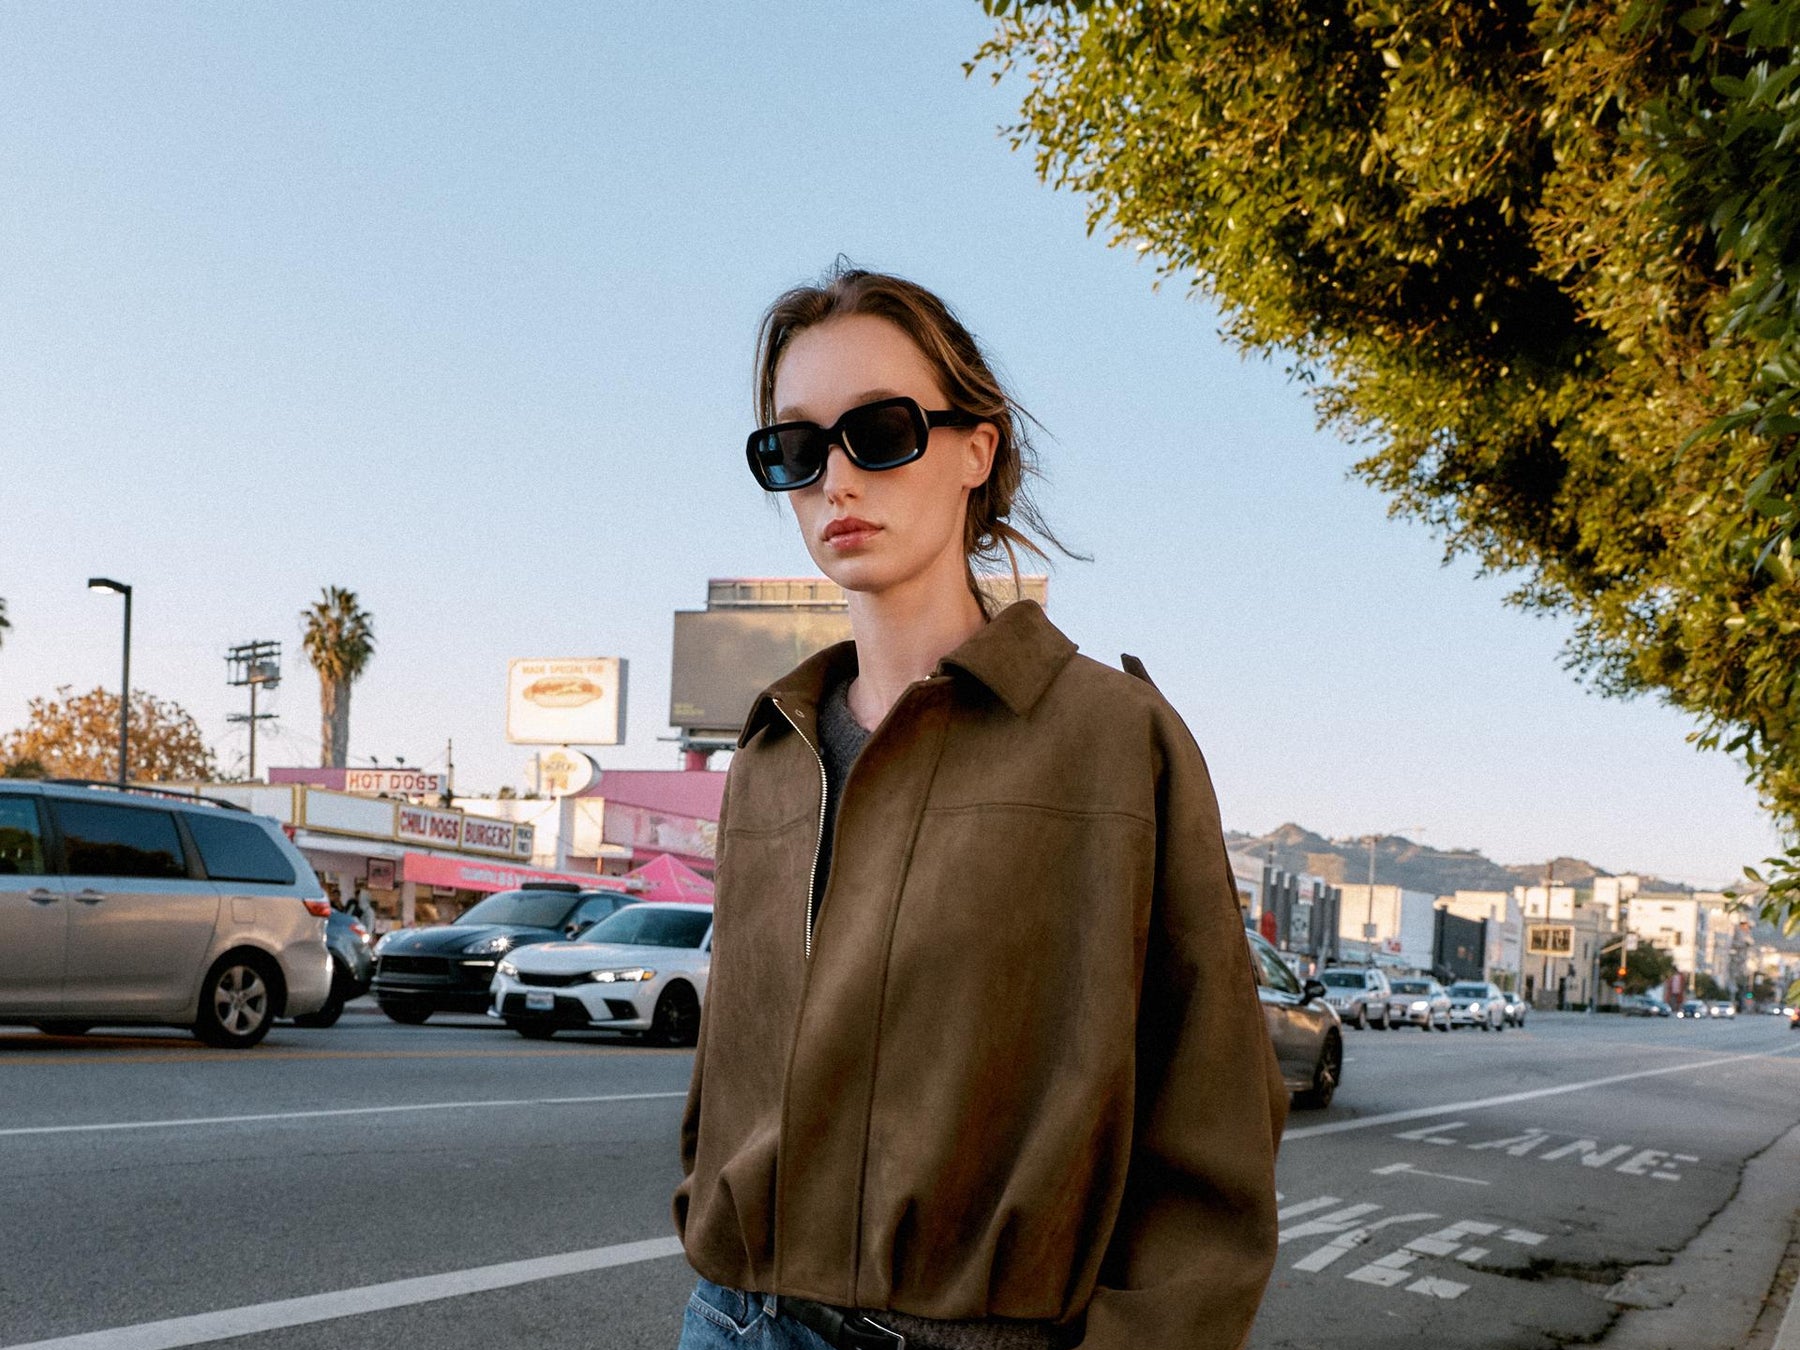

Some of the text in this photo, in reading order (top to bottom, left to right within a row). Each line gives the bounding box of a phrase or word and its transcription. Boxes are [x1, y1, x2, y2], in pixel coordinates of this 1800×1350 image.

[350, 773, 438, 790] HOT DOGS
[401, 811, 459, 840] CHILI DOGS
[465, 821, 511, 849] BURGERS
[1395, 1121, 1699, 1181] LANE
